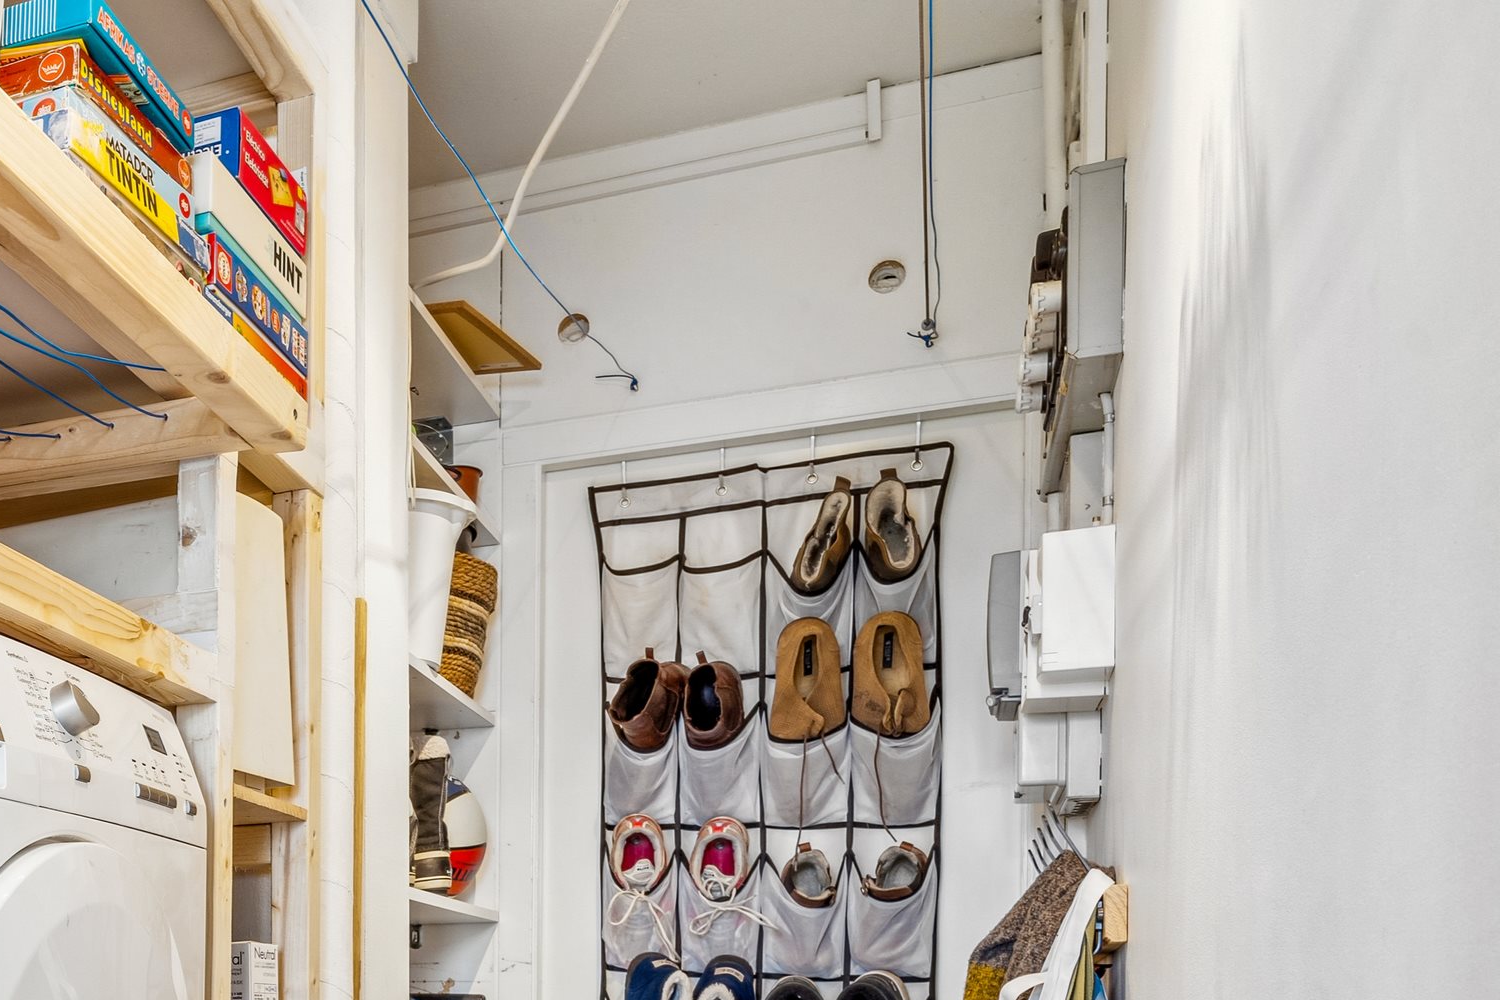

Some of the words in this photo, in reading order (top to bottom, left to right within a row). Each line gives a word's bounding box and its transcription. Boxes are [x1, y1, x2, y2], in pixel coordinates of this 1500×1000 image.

[80, 58, 153, 148] Disneyland
[106, 134, 155, 186] MATADOR
[106, 145, 159, 218] TINTIN
[273, 240, 303, 294] HINT
[254, 946, 276, 961] Neutral
